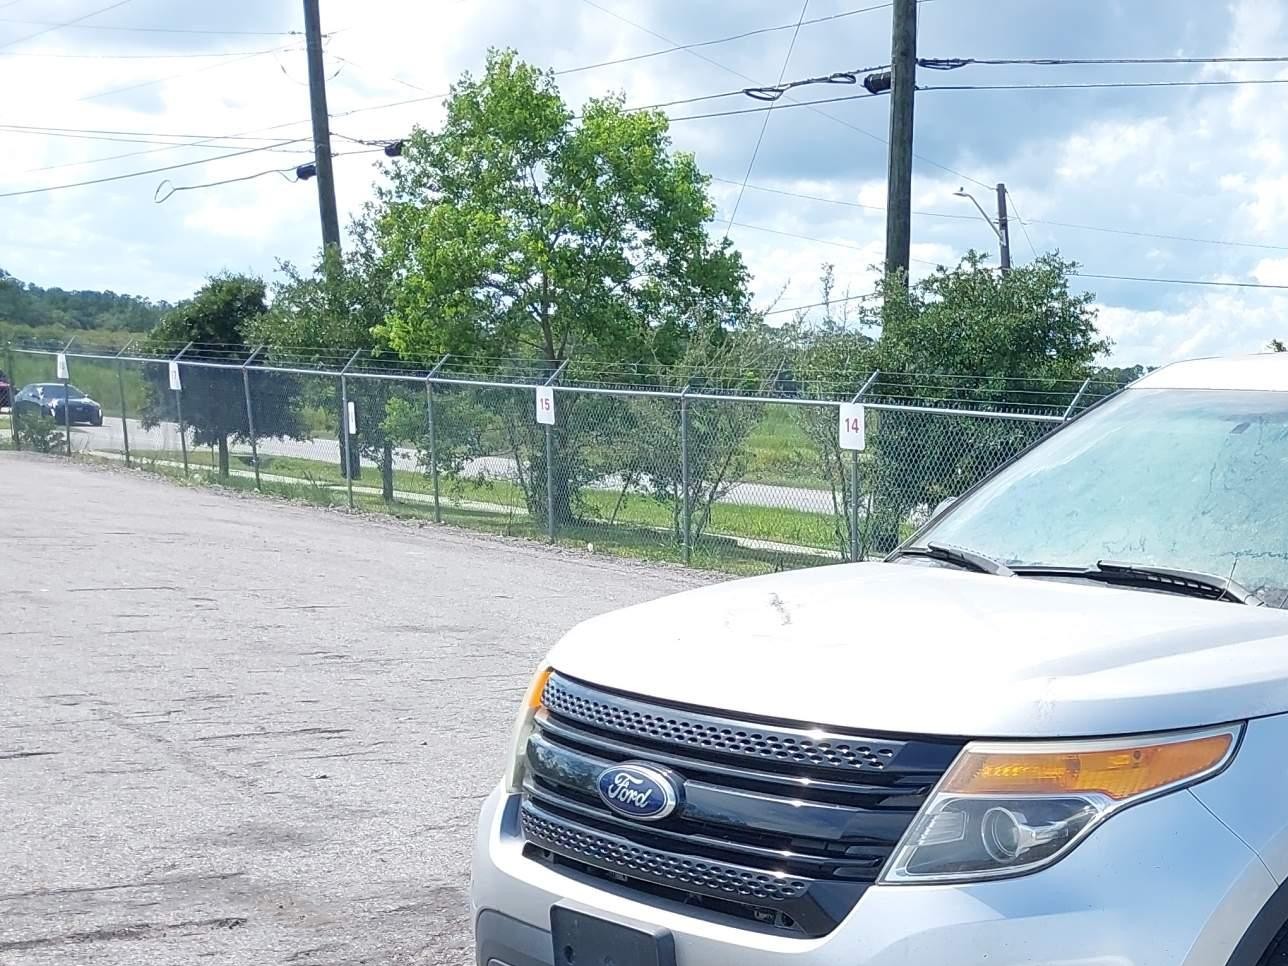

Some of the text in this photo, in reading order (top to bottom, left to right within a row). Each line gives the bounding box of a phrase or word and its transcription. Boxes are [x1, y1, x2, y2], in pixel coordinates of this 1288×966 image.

[540, 398, 550, 411] 15
[845, 418, 859, 433] 14
[608, 772, 652, 808] Ford
